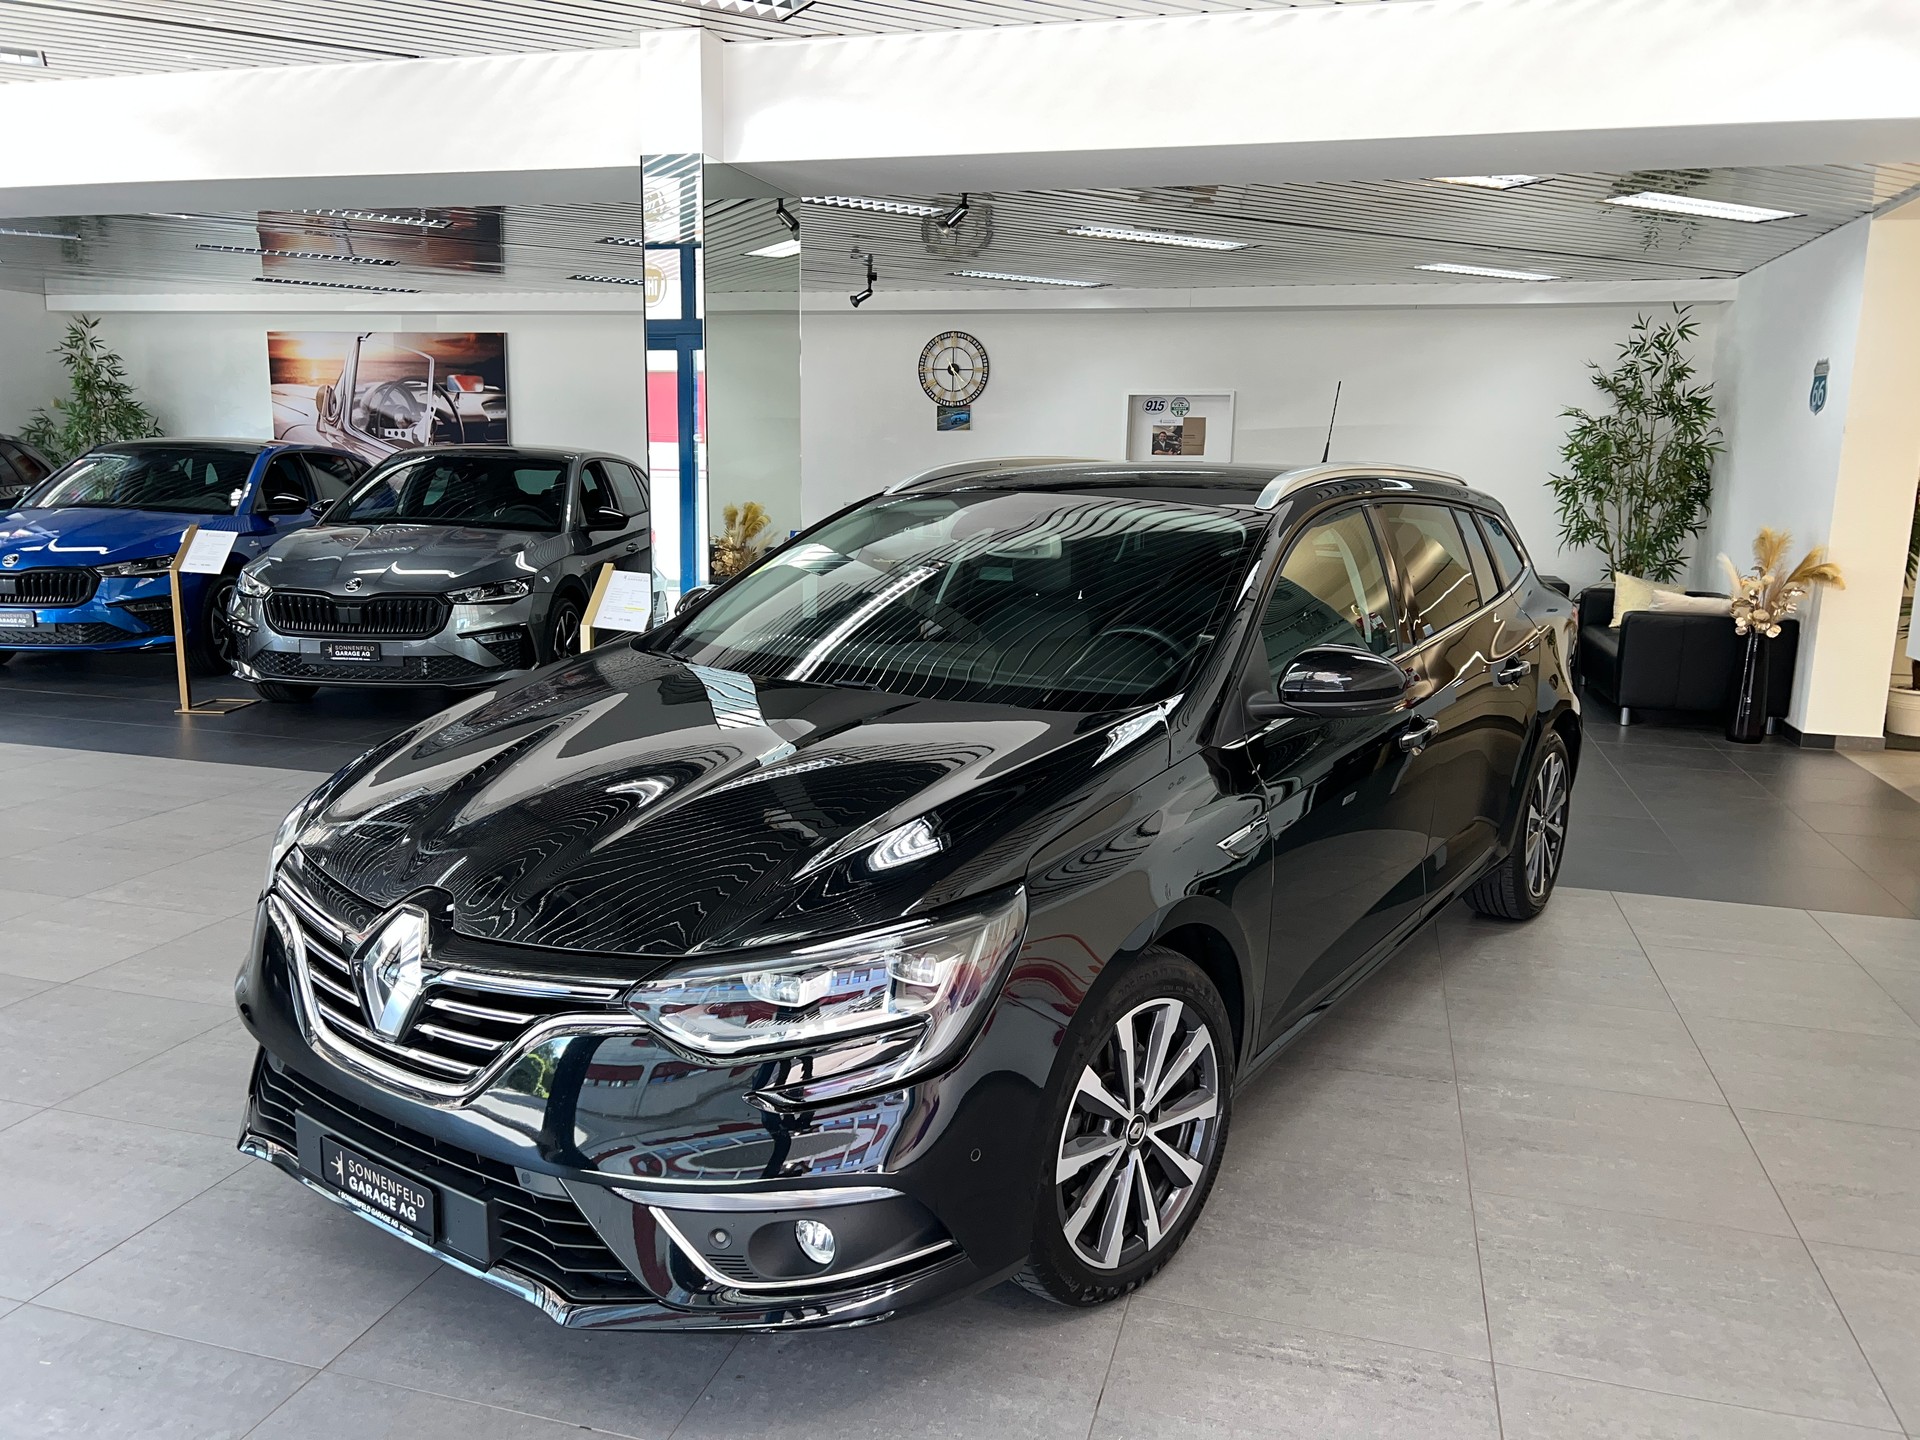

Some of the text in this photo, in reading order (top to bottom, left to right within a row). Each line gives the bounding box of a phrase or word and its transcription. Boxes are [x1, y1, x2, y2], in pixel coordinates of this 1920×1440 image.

[1145, 400, 1166, 412] 915
[1811, 380, 1825, 406] 66
[348, 1159, 425, 1209] SONNENFELD
[348, 1175, 417, 1222] GARAGE AG
